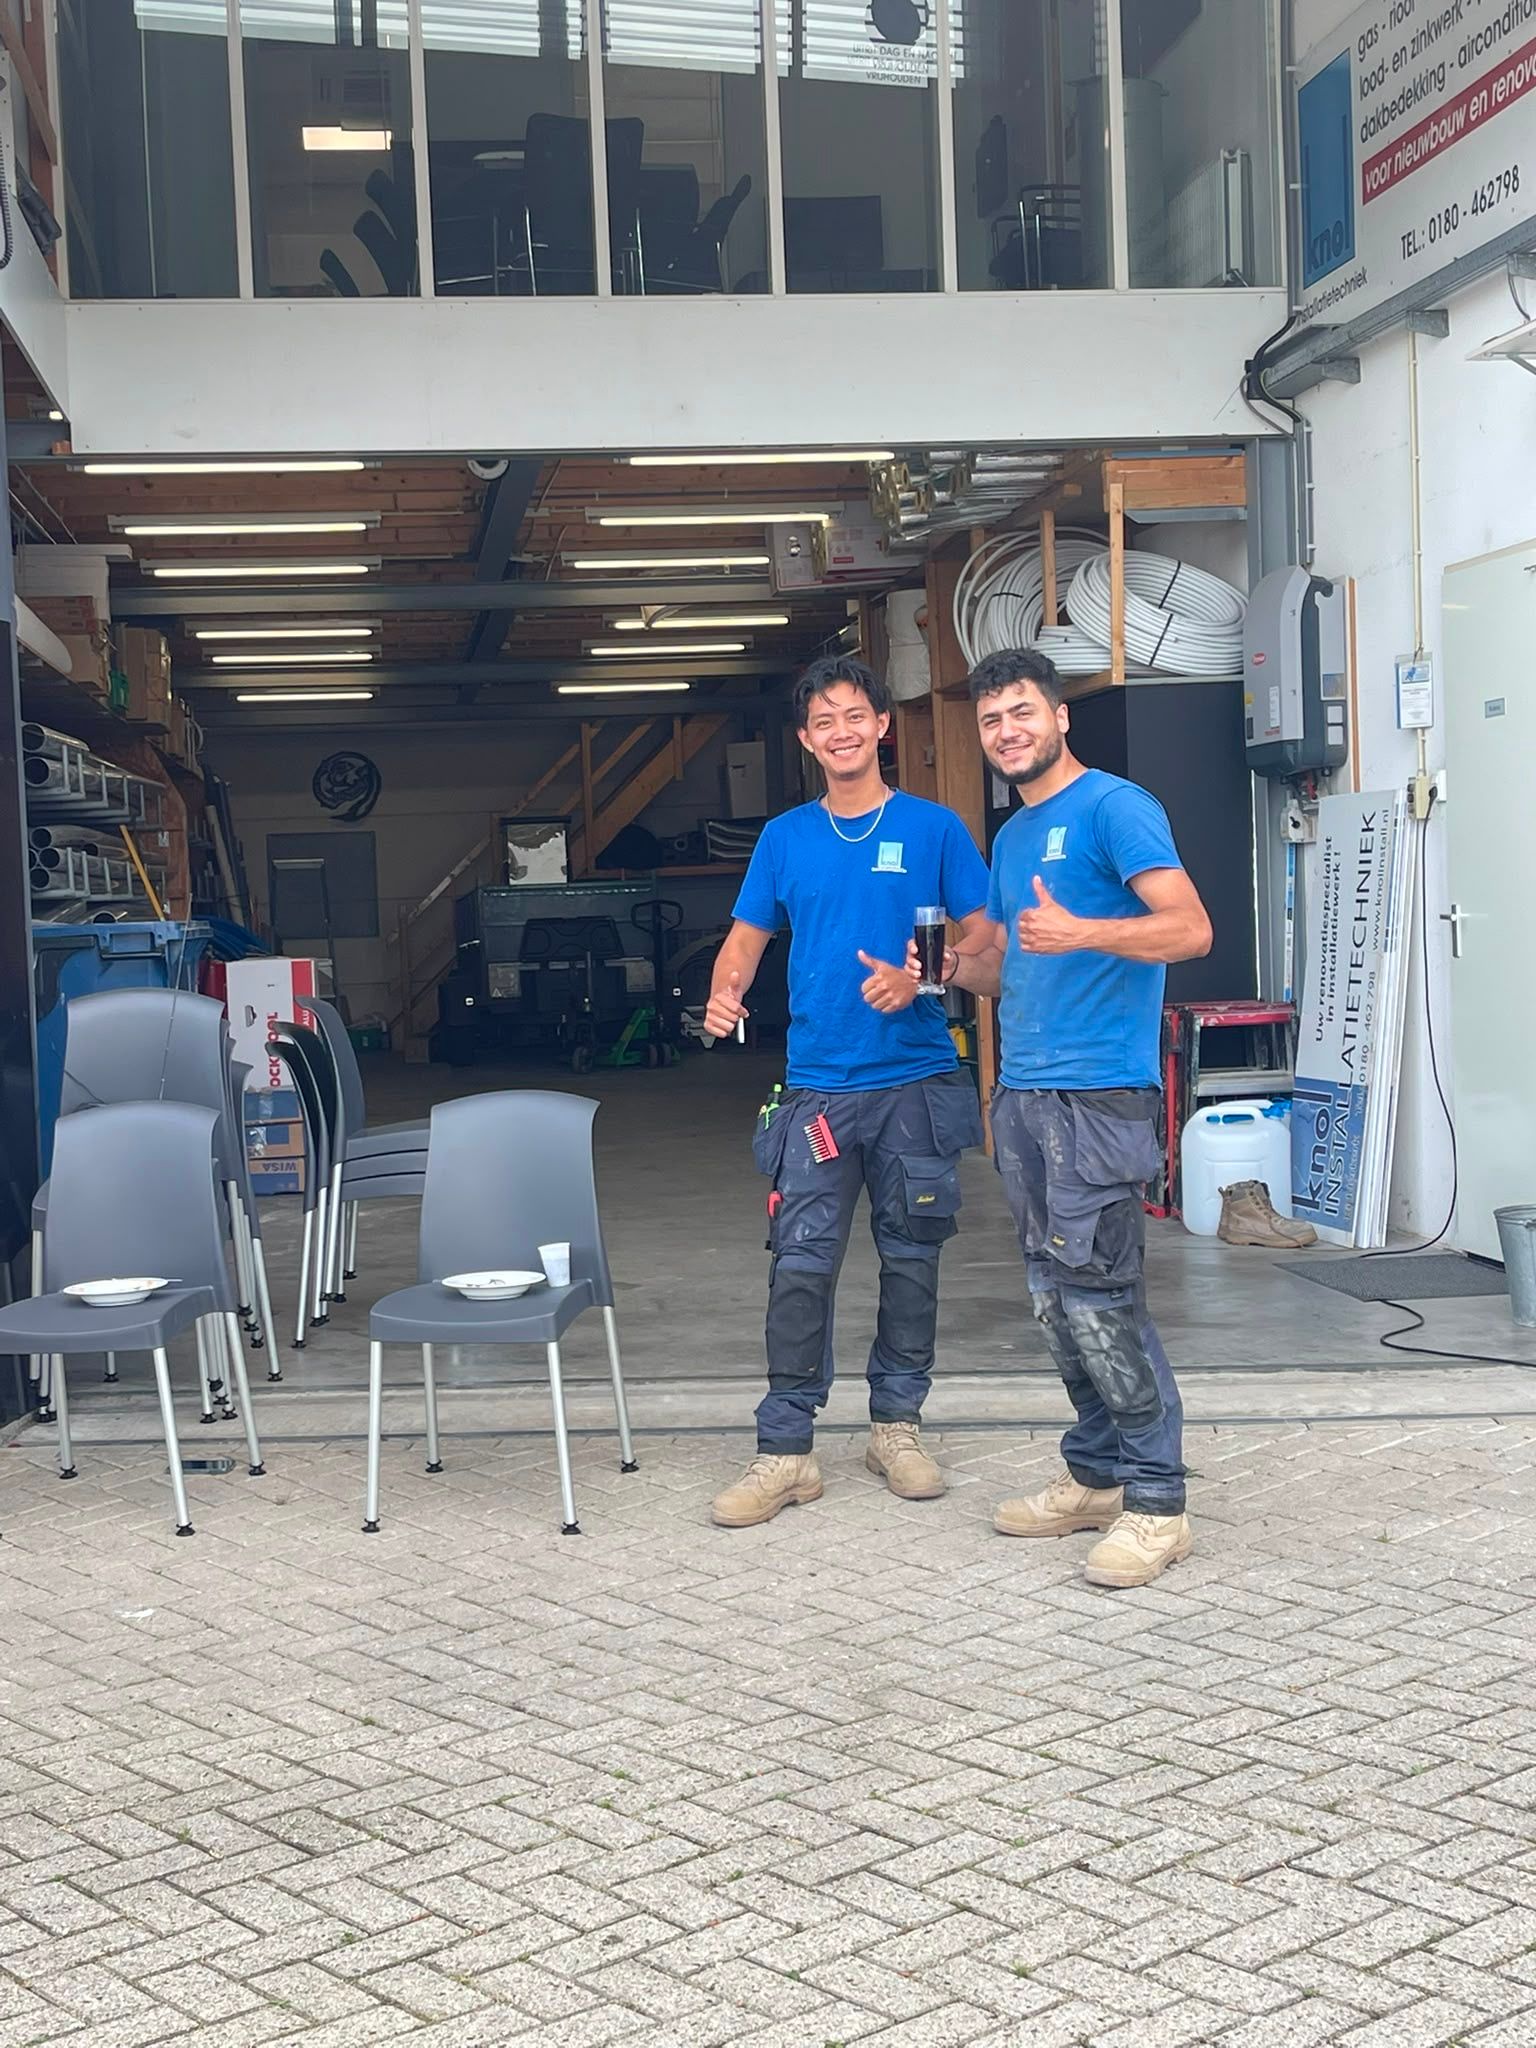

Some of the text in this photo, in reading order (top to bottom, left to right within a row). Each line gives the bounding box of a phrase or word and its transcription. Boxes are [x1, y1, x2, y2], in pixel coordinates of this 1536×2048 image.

[880, 45, 900, 57] DAG
[1358, 23, 1379, 62] gas
[1359, 58, 1389, 101] lood-
[1392, 45, 1407, 74] en
[1410, 1, 1463, 60] zinkwerk
[1360, 61, 1446, 143] dakbedekking
[1458, 0, 1536, 69] airconditio
[1366, 156, 1393, 194] voor
[1394, 103, 1467, 175] nieuwbouw
[1469, 89, 1488, 122] en
[1401, 229, 1425, 260] TEL.:
[1428, 203, 1459, 245] 0180
[1471, 164, 1520, 217] 462798
[1315, 836, 1333, 1042] Uw renovatiespecialist
[1326, 862, 1341, 999] installatiewerk
[1323, 811, 1377, 1217] INSTALLATIETECHNIEK
[1325, 1005, 1334, 1022] in
[1364, 1003, 1374, 1032] 462
[1366, 970, 1376, 1000] 798
[267, 1012, 281, 1087] OCKOOL
[1359, 1044, 1369, 1083] 0180
[262, 1163, 297, 1172] WISA
[1292, 1088, 1333, 1211] knol
